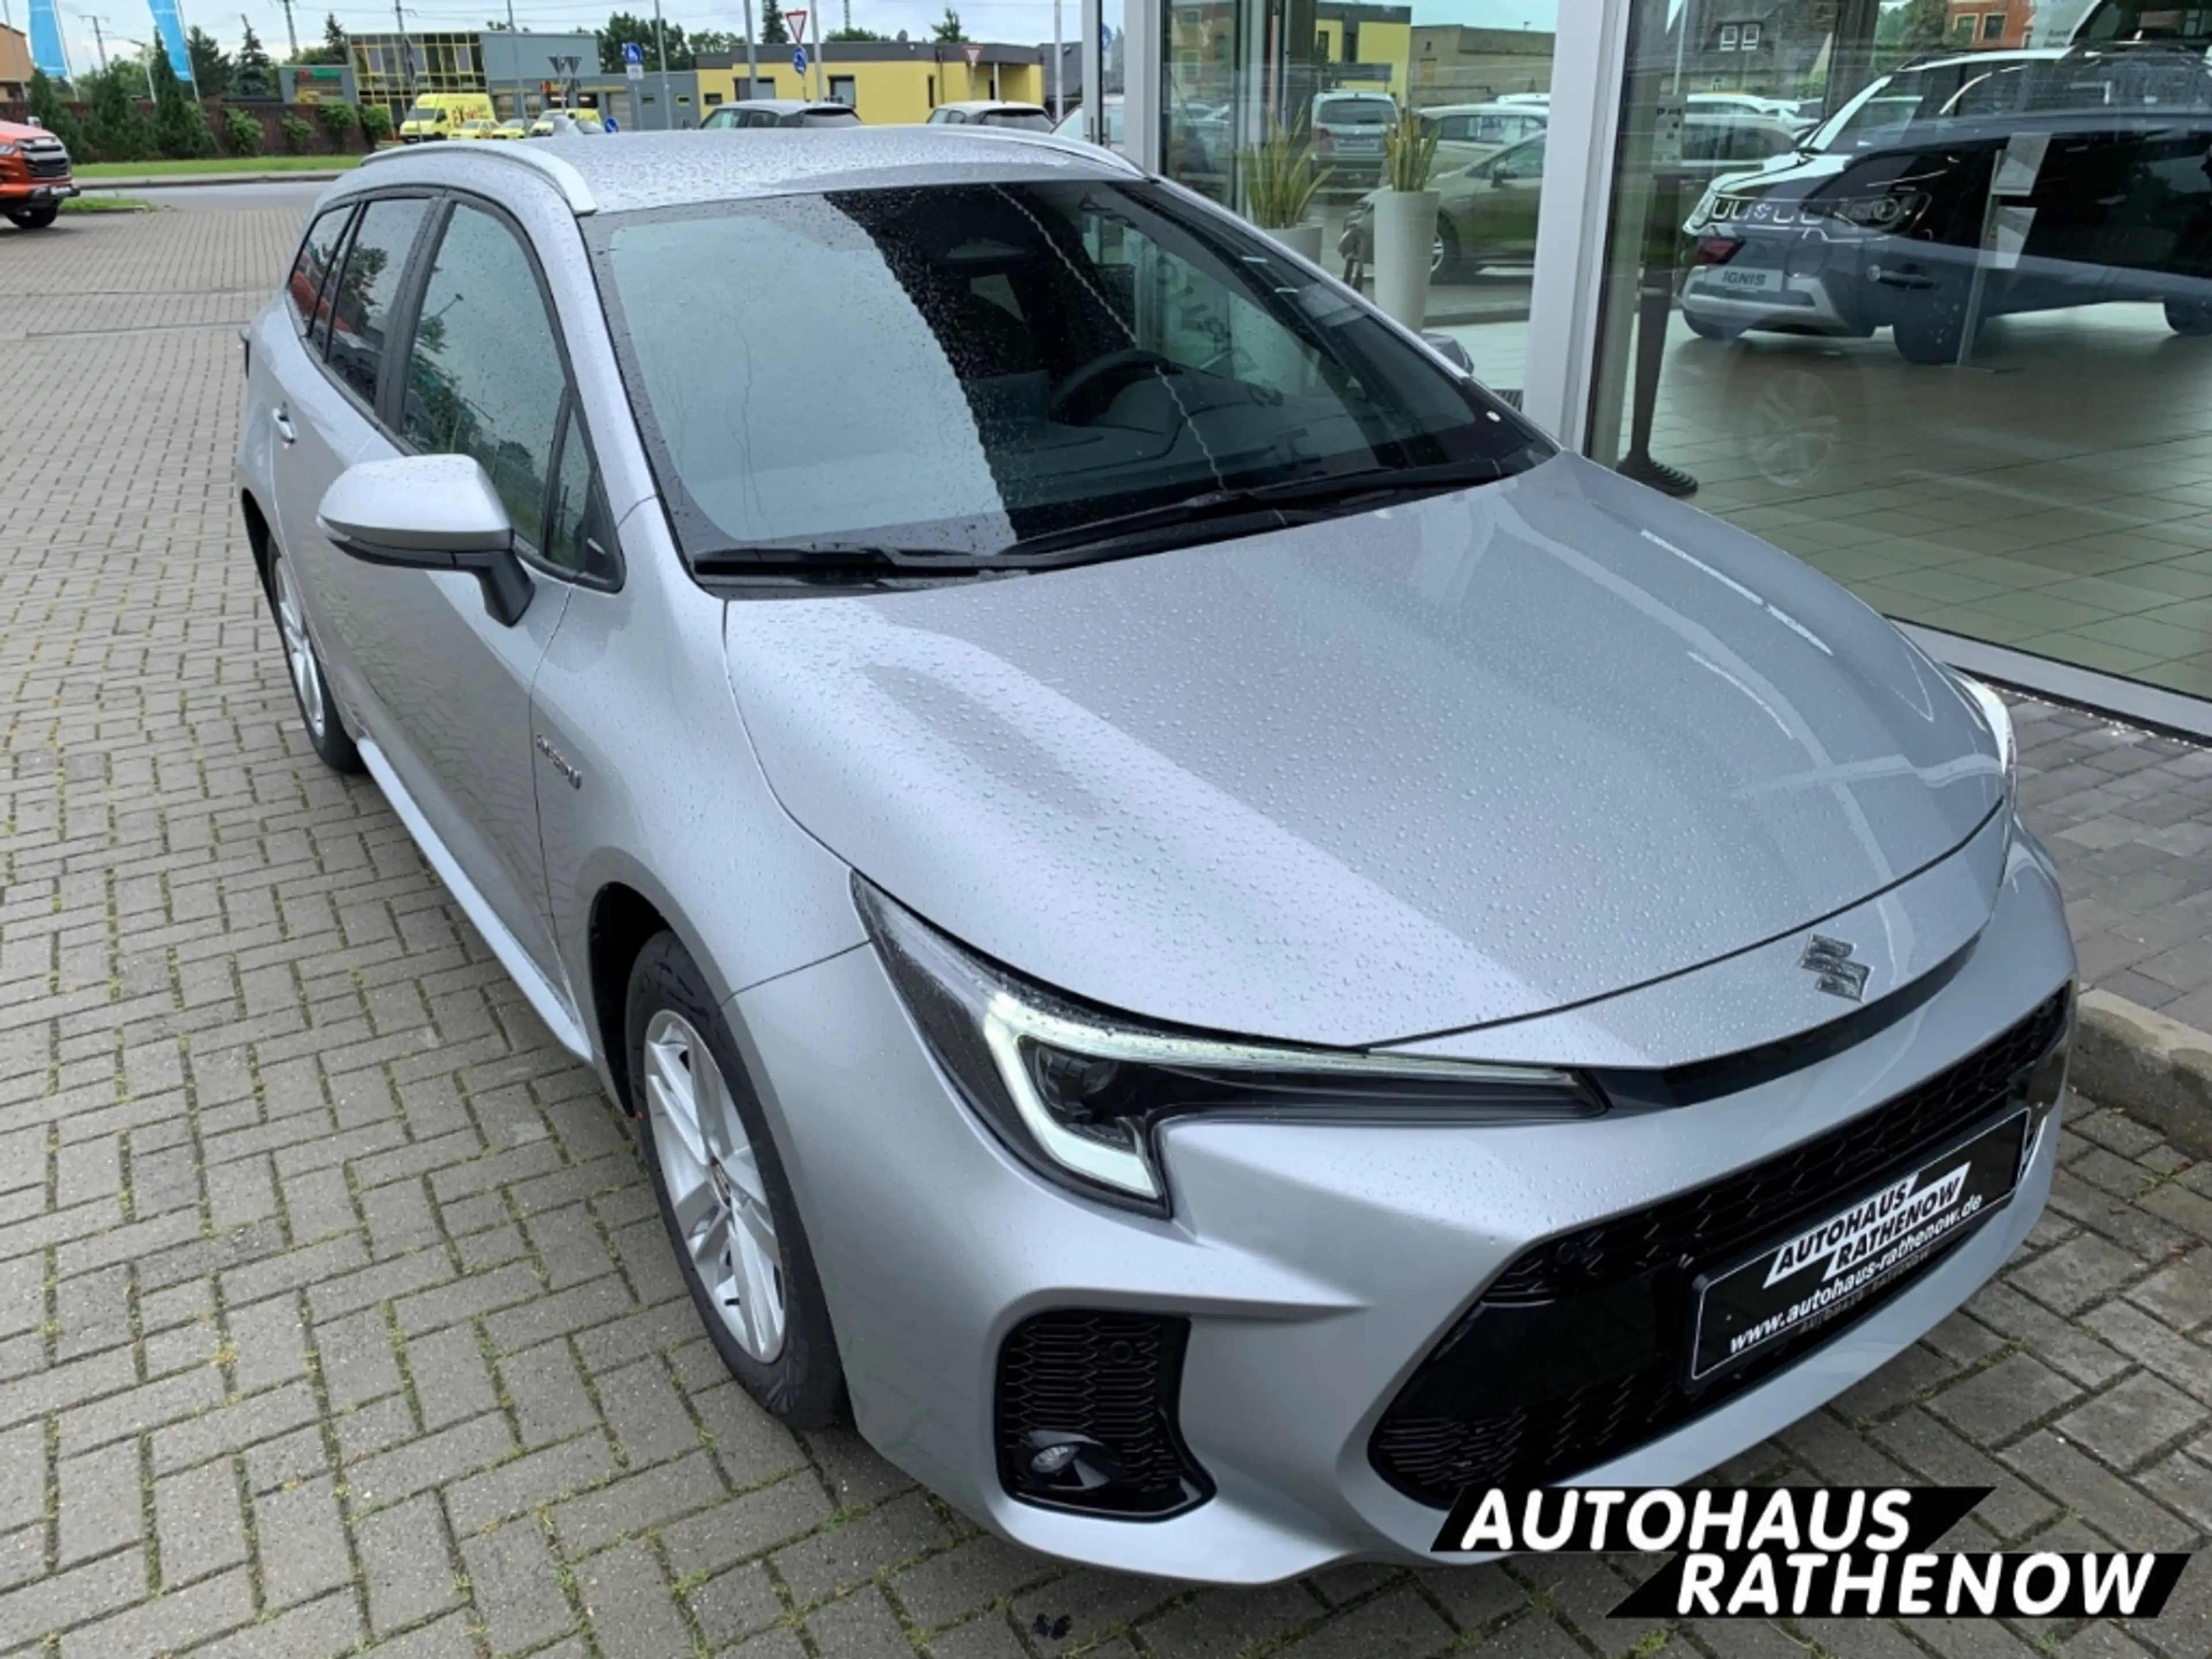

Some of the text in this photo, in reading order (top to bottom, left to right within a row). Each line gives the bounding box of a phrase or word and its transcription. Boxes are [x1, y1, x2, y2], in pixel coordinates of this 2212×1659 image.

[1723, 271, 1767, 286] IGNIS
[1776, 1182, 1908, 1274] AUTOHAUS
[1836, 1177, 1960, 1269] RATHENOW
[1729, 1194, 1982, 1354] www.autohaus-rathenow.de
